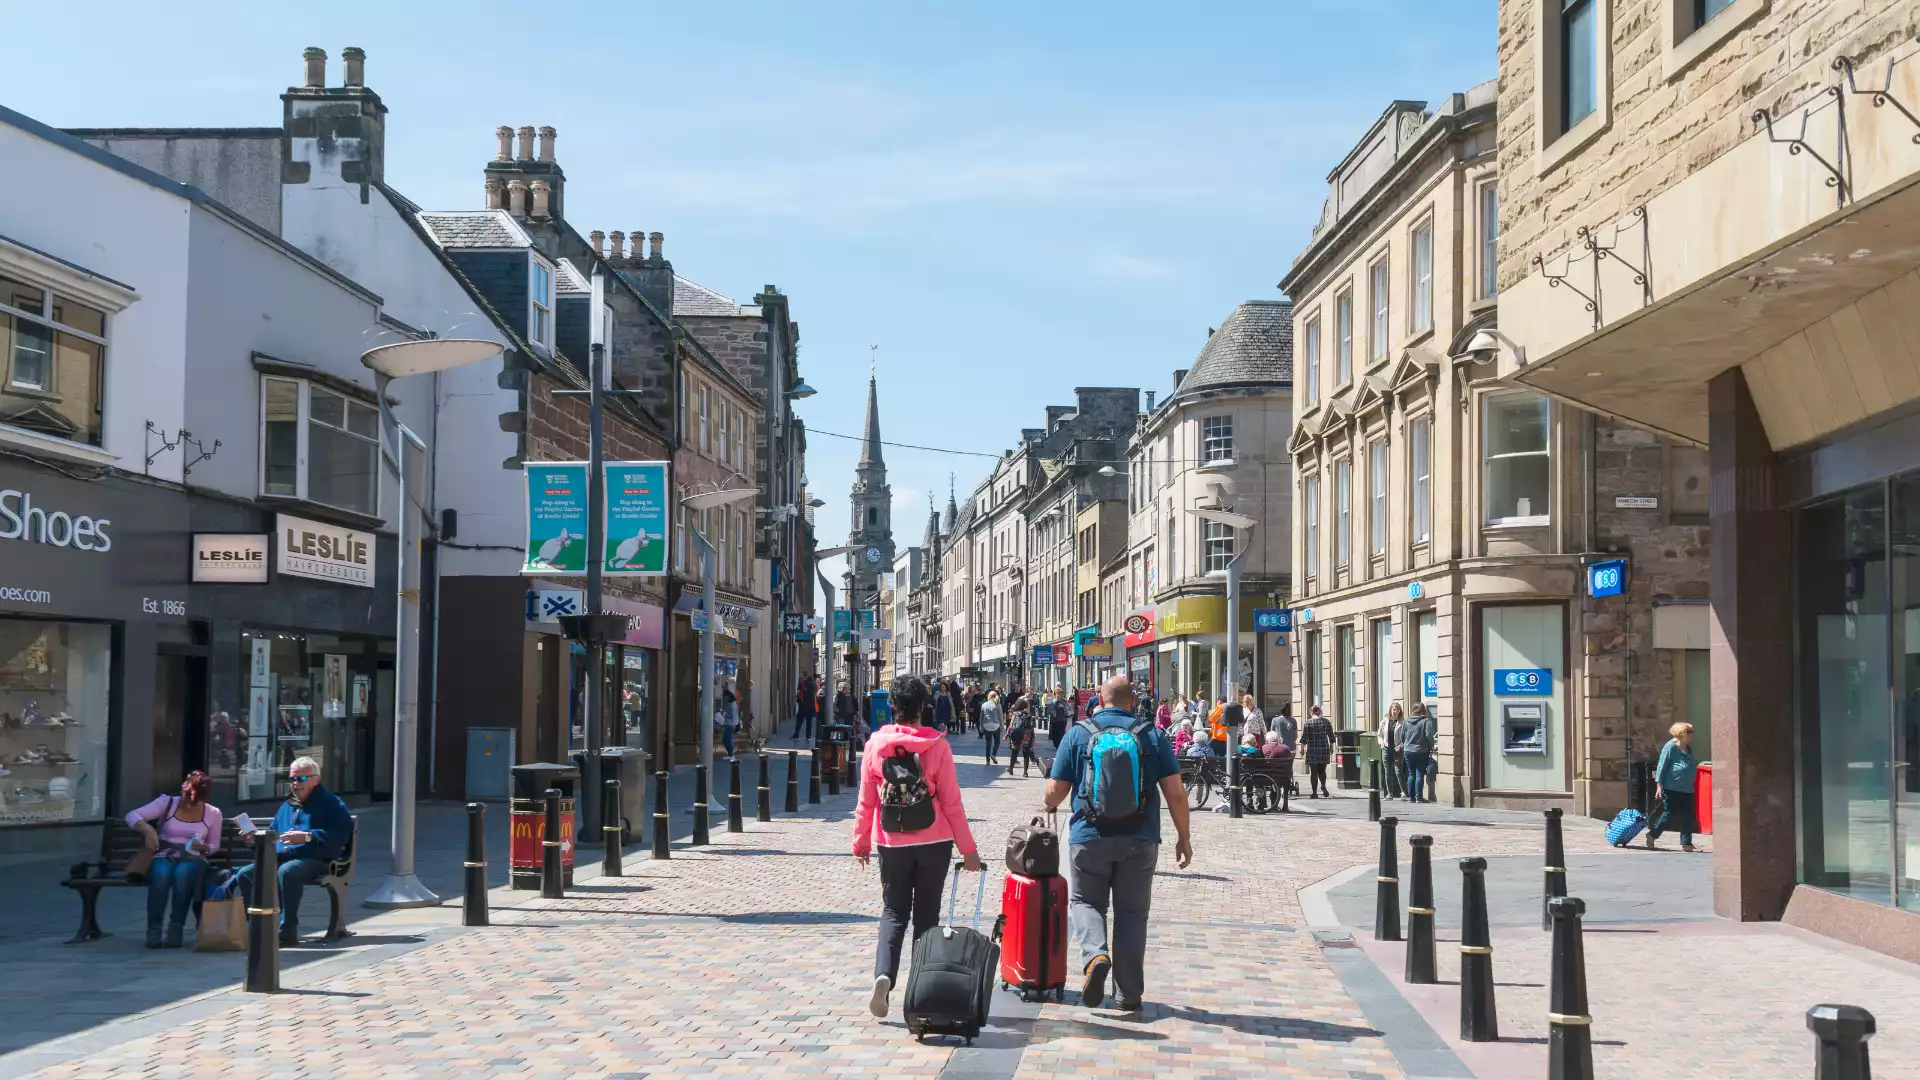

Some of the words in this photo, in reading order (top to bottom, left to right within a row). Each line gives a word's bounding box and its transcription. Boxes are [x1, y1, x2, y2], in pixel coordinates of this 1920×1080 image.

[0, 489, 111, 552] Shoes
[1595, 569, 1616, 588] SB
[143, 598, 158, 613] Est.
[162, 600, 186, 616] 1866
[1260, 615, 1287, 625] TSB
[1507, 674, 1538, 685] TSB
